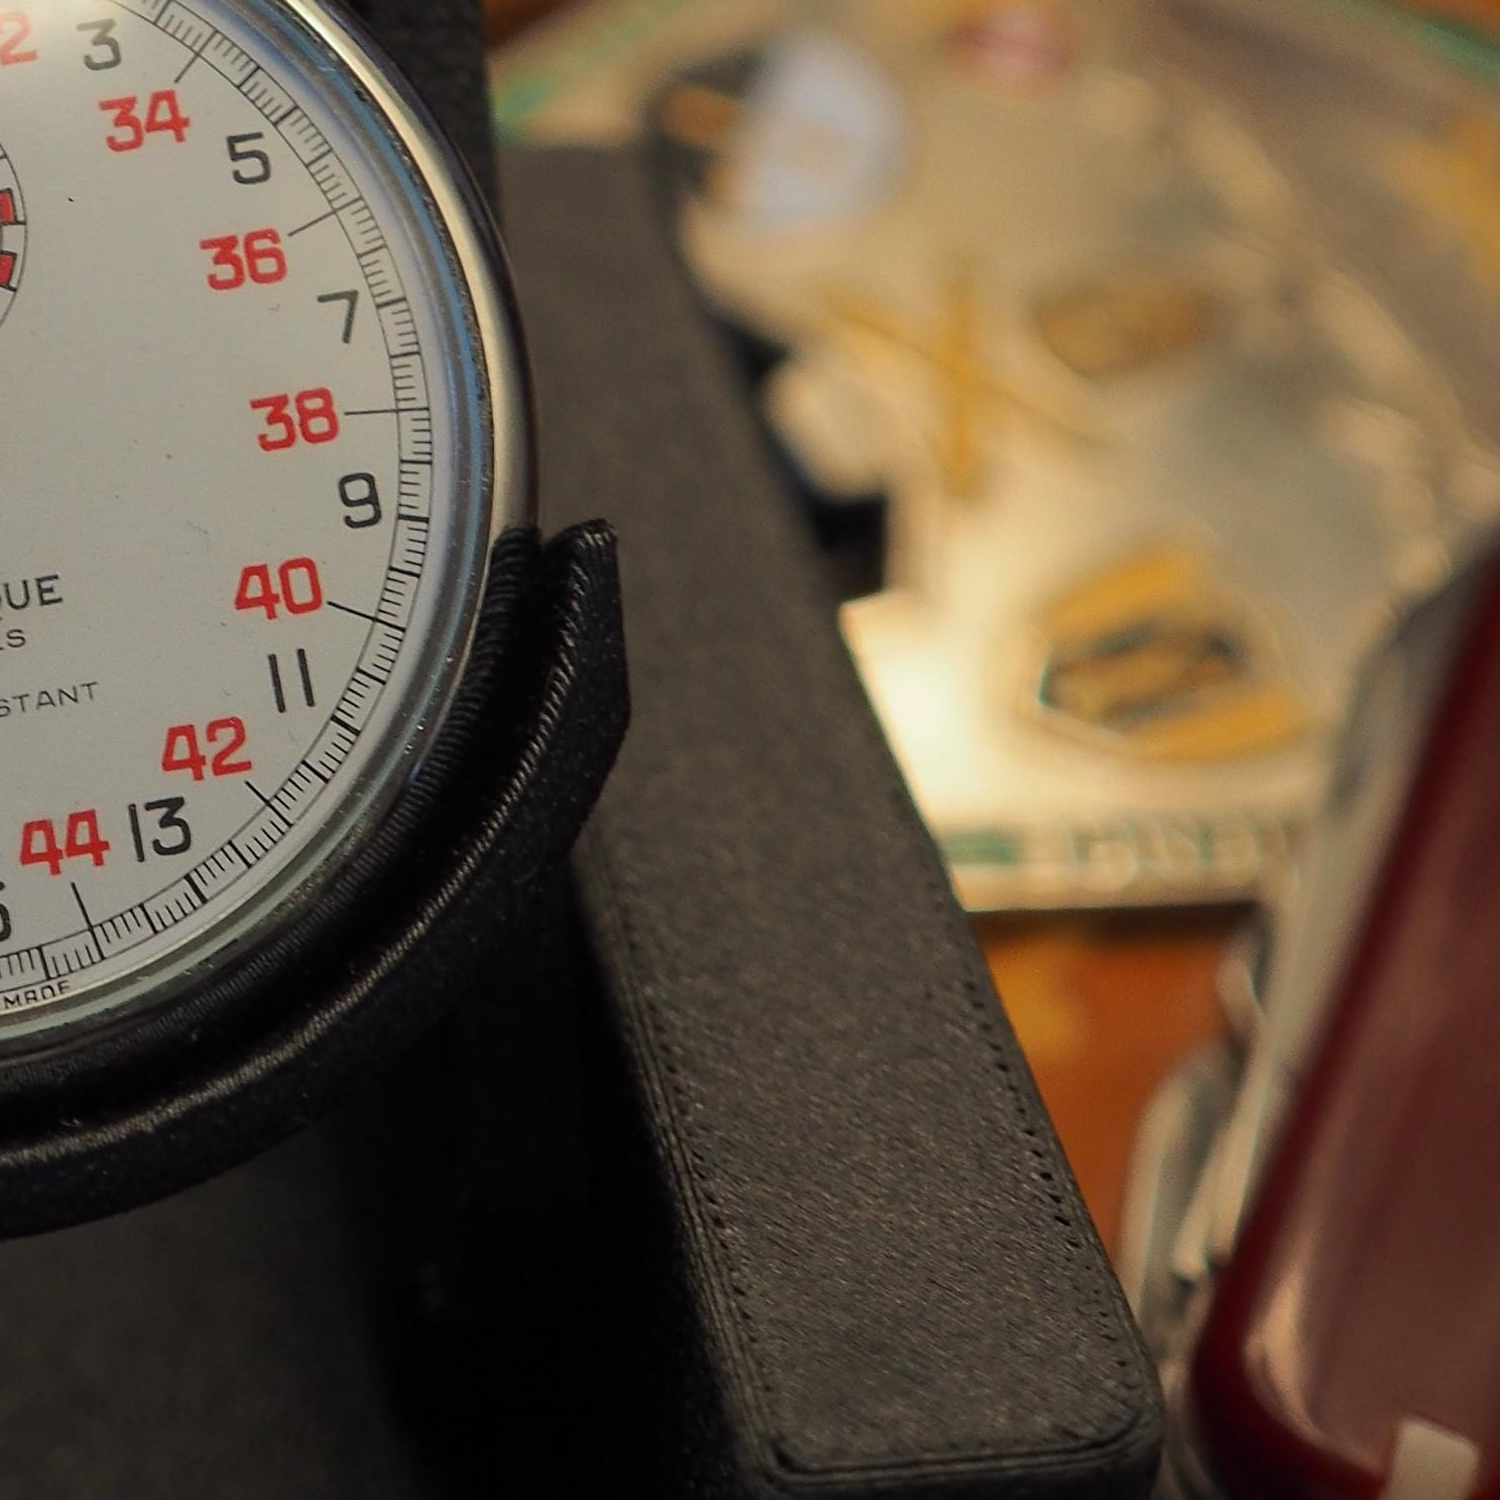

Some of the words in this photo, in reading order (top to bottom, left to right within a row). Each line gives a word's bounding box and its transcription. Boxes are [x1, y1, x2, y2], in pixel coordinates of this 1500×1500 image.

[77, 18, 122, 71] 3
[99, 90, 190, 152] 34
[226, 132, 271, 185] 5
[200, 228, 288, 291] 36
[316, 289, 359, 343] 7
[250, 387, 339, 452] 38
[338, 472, 382, 528] 9
[234, 557, 323, 620] 40
[268, 648, 316, 714] 11
[161, 717, 252, 781] 42
[19, 809, 110, 875] 44
[128, 796, 193, 863] 13
[3, 979, 72, 1010] MADE
